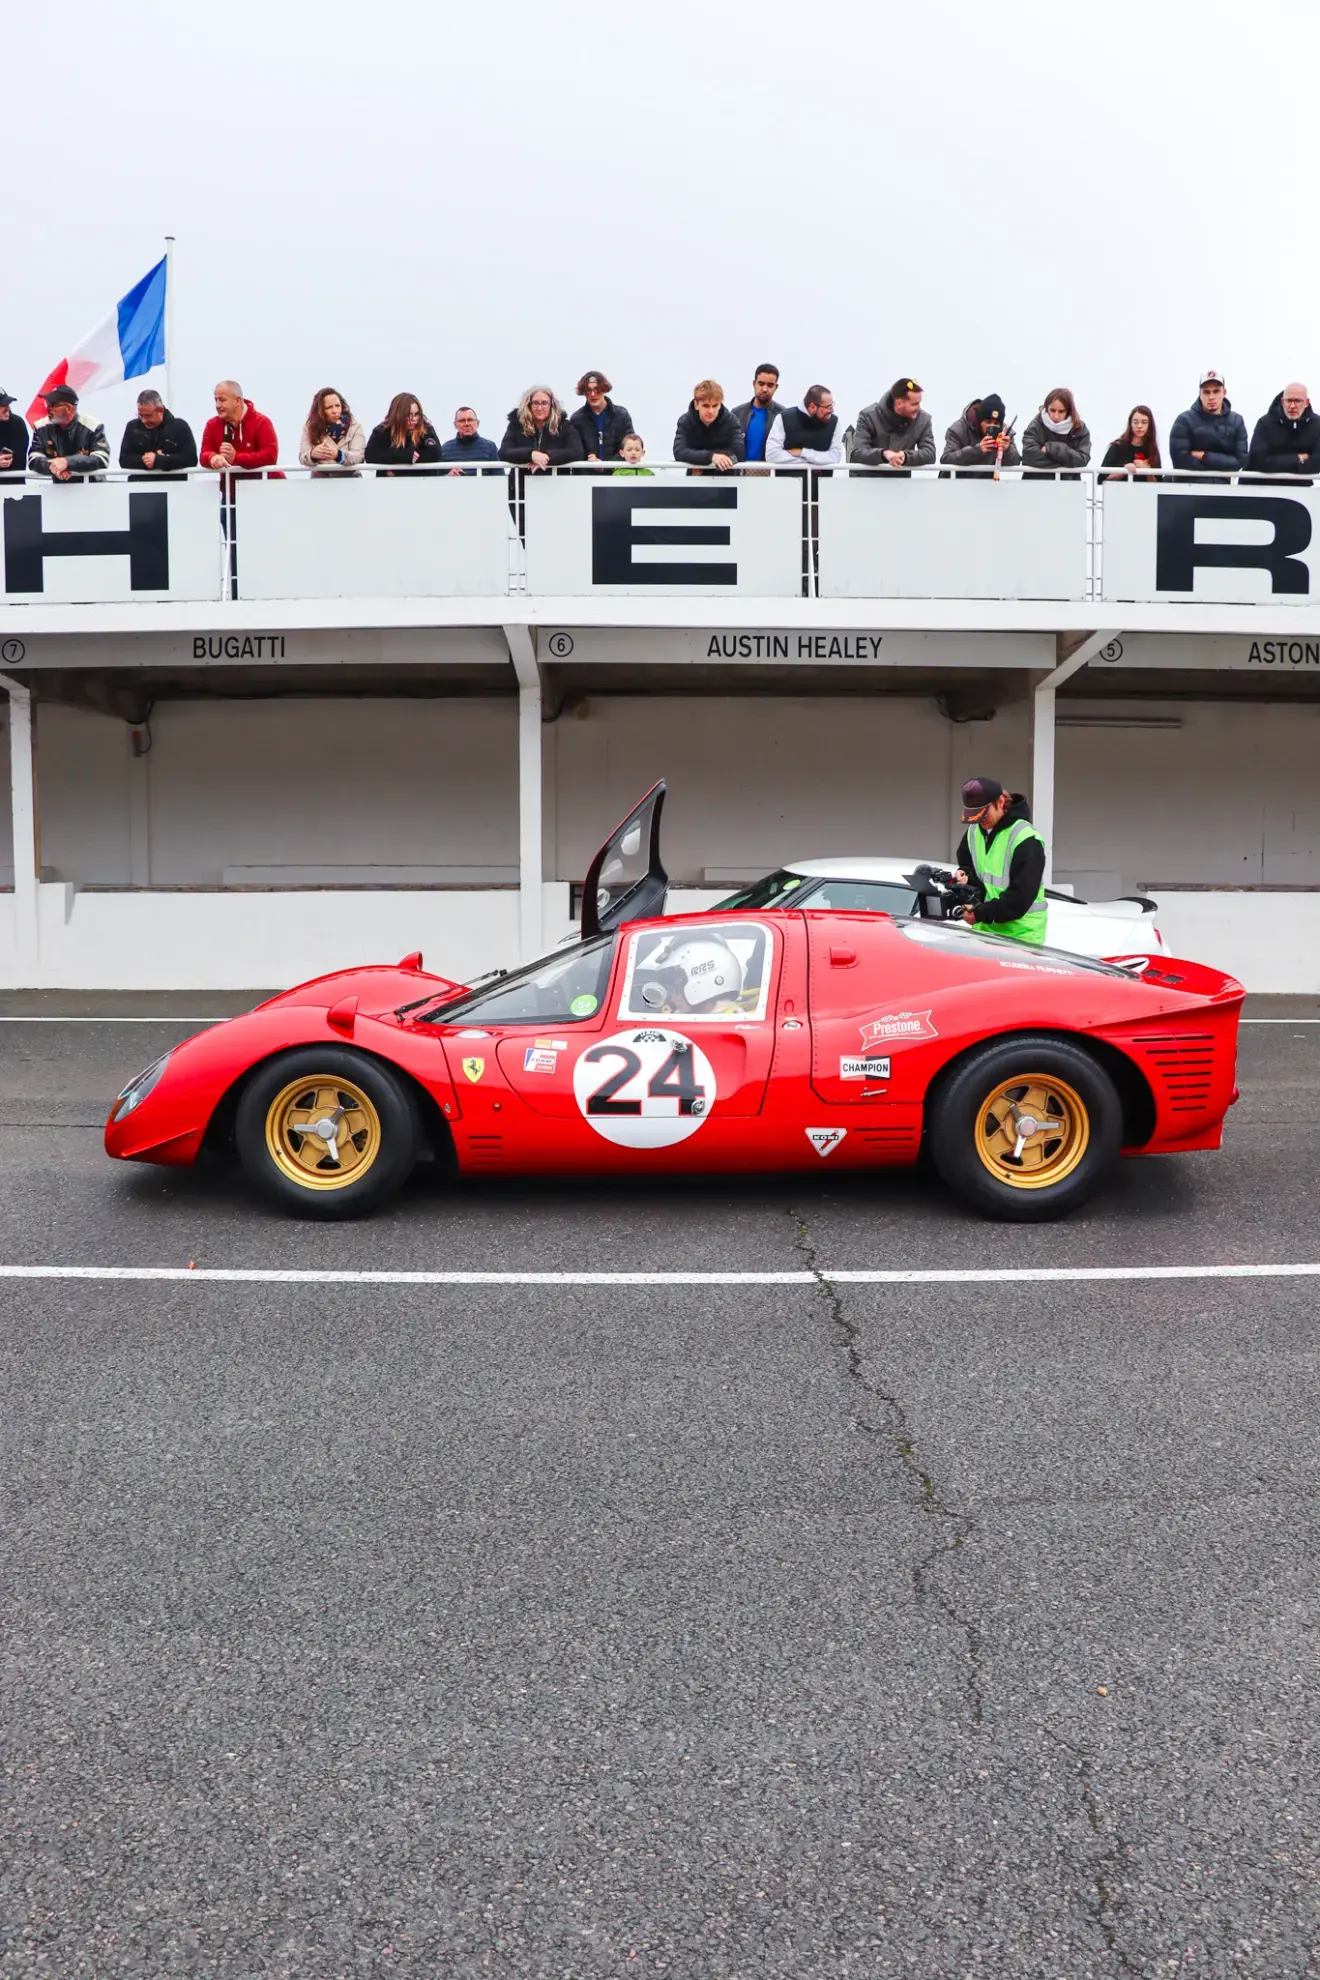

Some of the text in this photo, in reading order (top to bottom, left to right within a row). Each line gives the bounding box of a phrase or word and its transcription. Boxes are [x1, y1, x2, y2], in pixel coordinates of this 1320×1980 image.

[592, 486, 737, 585] E
[1156, 494, 1312, 594] R
[193, 636, 285, 659] BUGATTI
[707, 635, 883, 659] AUSTIN HEALEY
[1248, 641, 1320, 665] ASTON
[690, 960, 716, 976] RRS
[873, 1020, 921, 1036] Prestone
[584, 1043, 706, 1116] 24
[842, 1063, 889, 1073] CHAMPION
